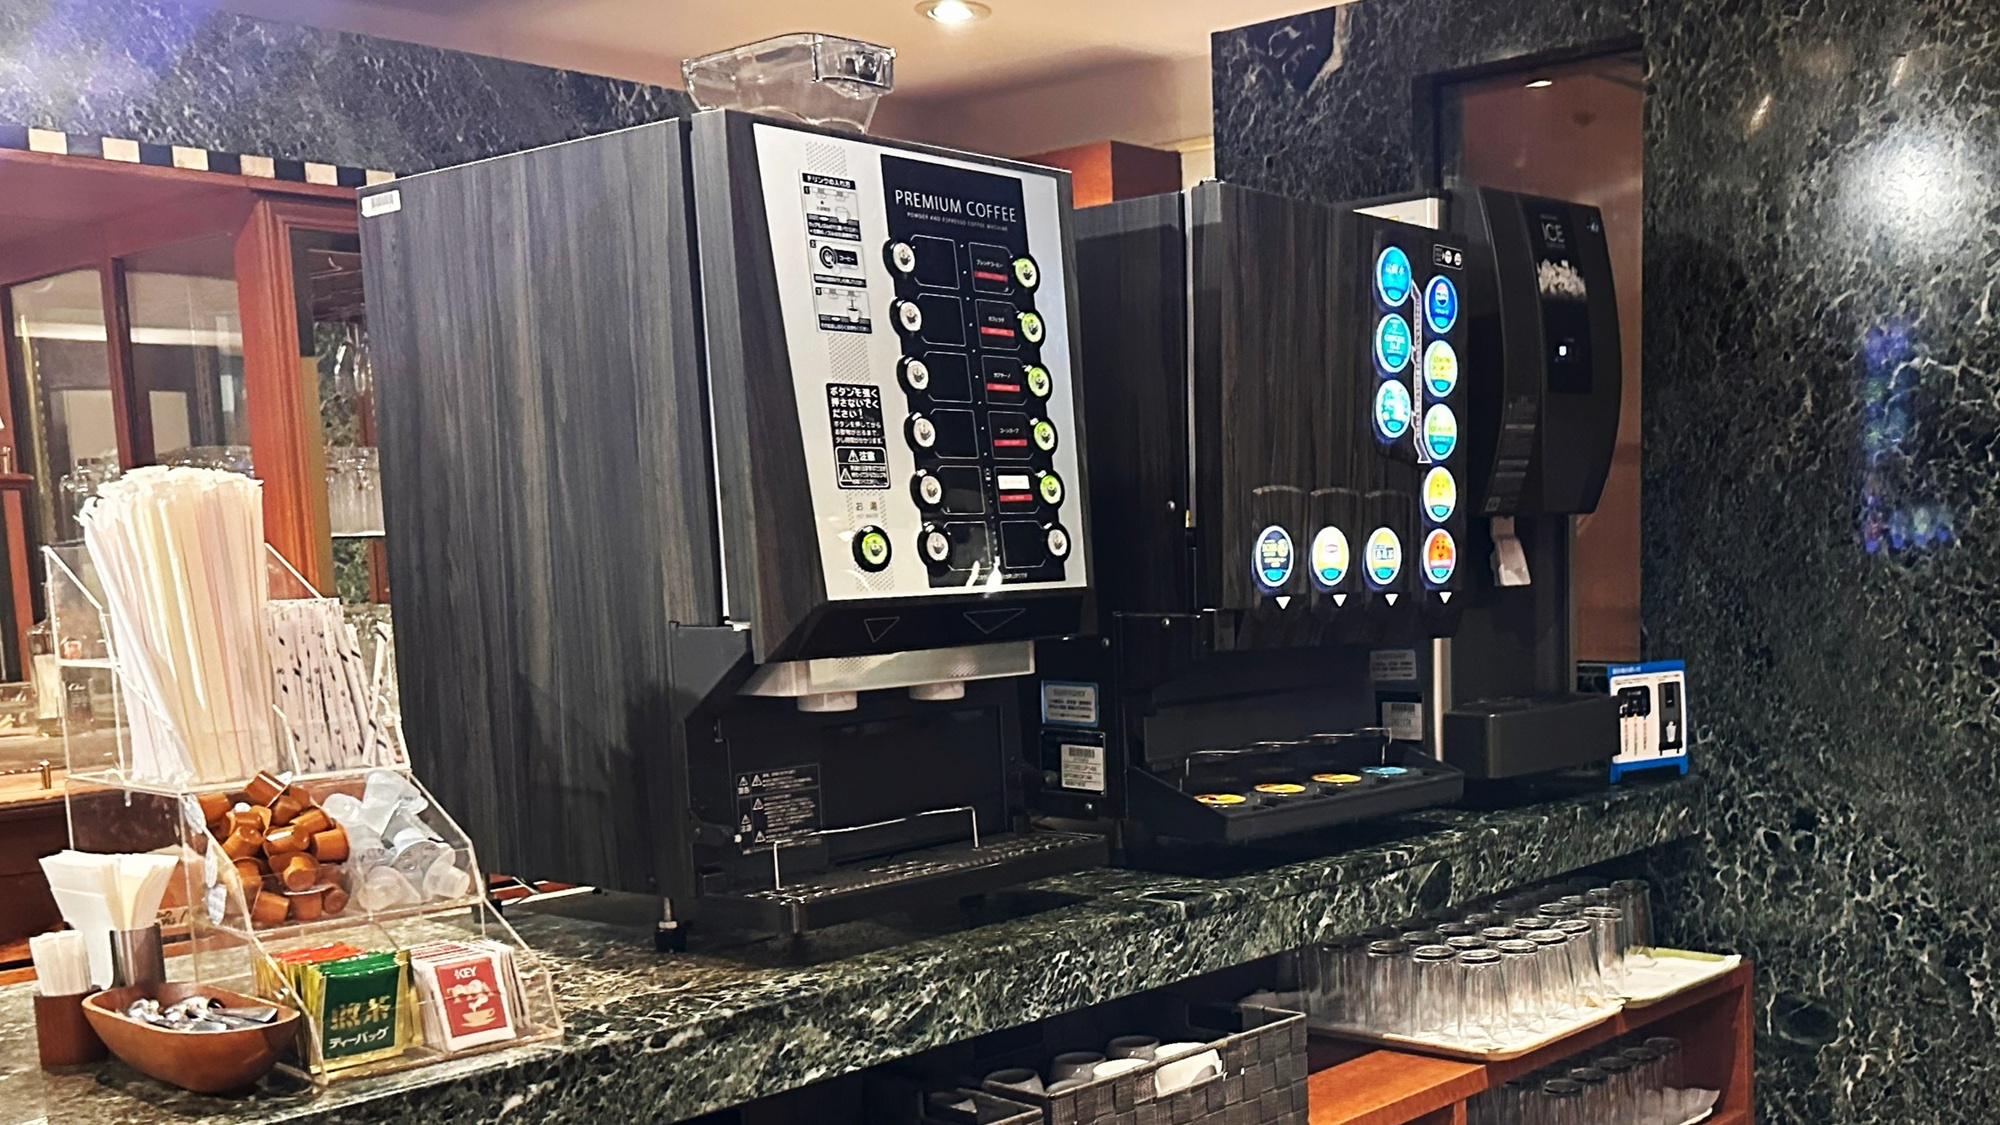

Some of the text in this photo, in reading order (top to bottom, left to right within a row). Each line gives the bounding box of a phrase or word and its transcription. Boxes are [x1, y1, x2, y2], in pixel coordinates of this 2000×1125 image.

[895, 189, 1017, 223] PREMIUM COFFEE
[906, 211, 929, 220] POWDER
[942, 216, 966, 226] ESPRESSO
[967, 221, 986, 229] COFFEE
[1541, 222, 1565, 243] ICE
[830, 386, 878, 398] ボタンを強く
[831, 397, 879, 409] 押さないでく
[454, 966, 477, 980] KEY
[329, 1026, 390, 1050] ティーバッグ
